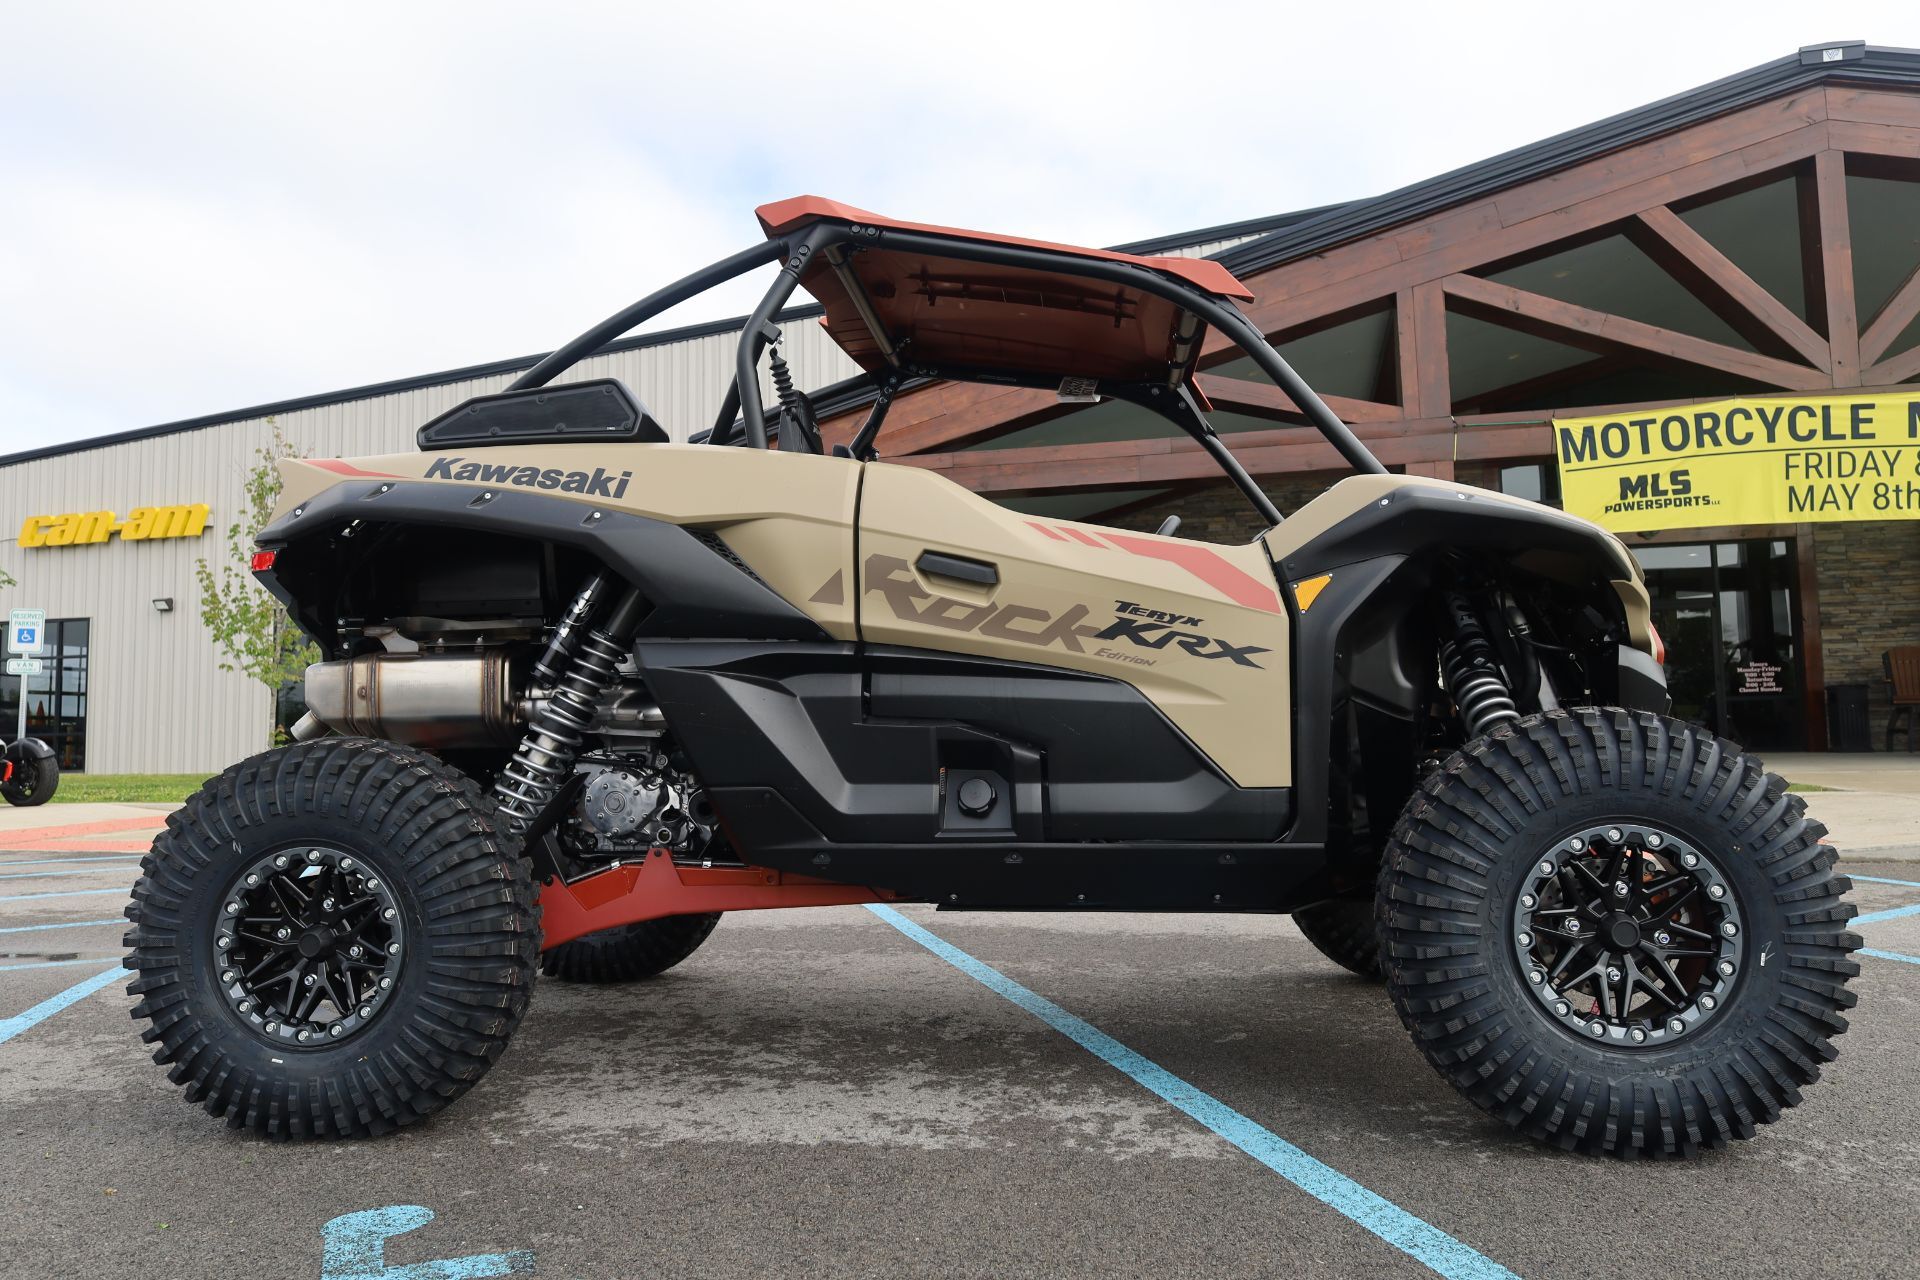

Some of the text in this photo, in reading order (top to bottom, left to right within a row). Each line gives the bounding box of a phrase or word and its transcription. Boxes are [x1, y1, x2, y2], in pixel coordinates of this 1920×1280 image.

[1559, 403, 1876, 464] MOTORCYCLE
[424, 457, 632, 499] Kawasaki
[1785, 449, 1902, 480] FRIDAY
[1619, 469, 1692, 500] MLS
[1788, 483, 1860, 512] MAY
[1604, 495, 1711, 514] POWERSPORTS
[17, 503, 210, 548] can-am
[1094, 616, 1274, 670] KRX
